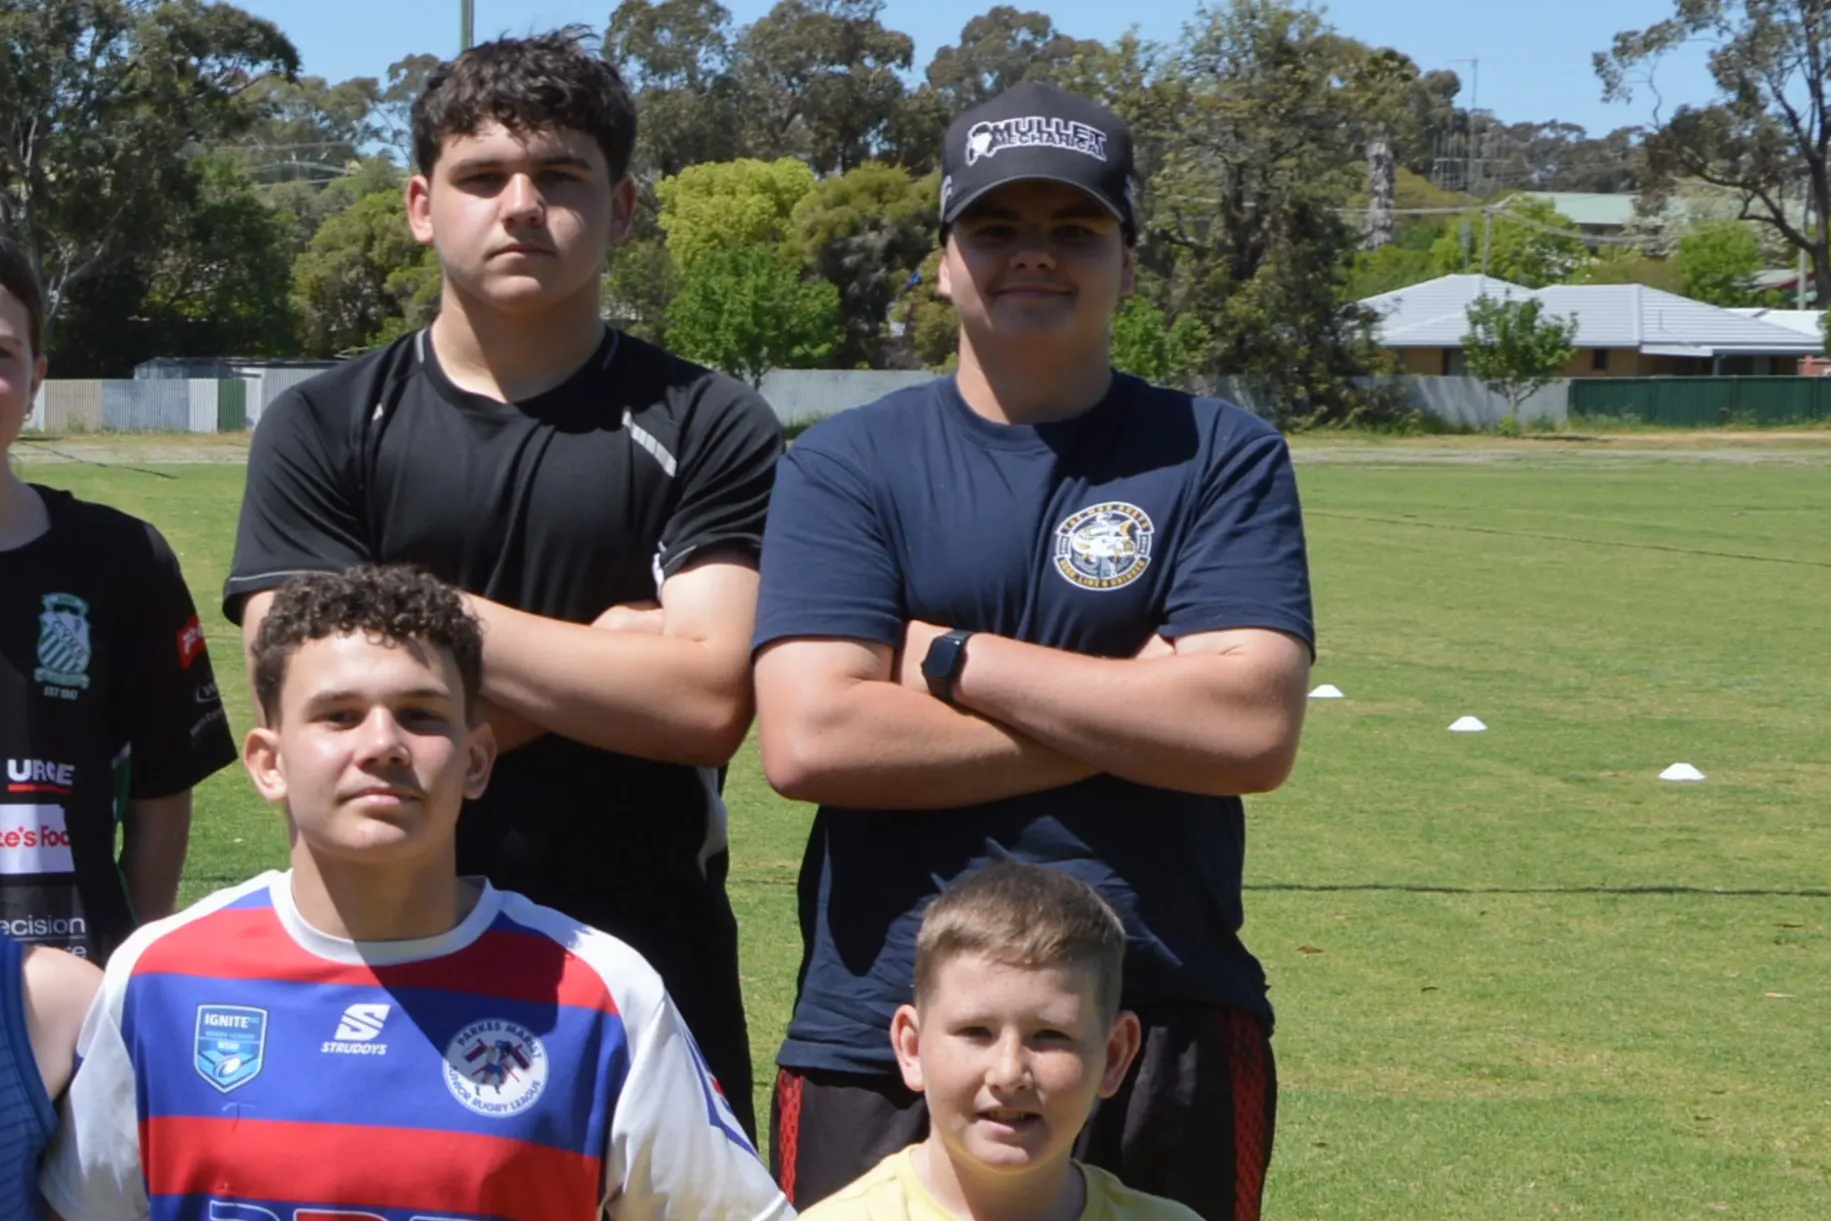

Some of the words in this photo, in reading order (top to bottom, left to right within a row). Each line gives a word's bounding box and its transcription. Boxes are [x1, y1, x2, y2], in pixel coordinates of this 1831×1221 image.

[991, 116, 1107, 146] MULLET
[7, 758, 75, 785] URGE
[204, 1013, 249, 1029] IGNITE
[320, 1041, 388, 1056] STRUDDYS
[457, 1021, 501, 1046] PARKES
[505, 1023, 542, 1059] MARIST
[471, 1097, 508, 1112] RUGBY
[509, 1080, 542, 1111] LEAGUE
